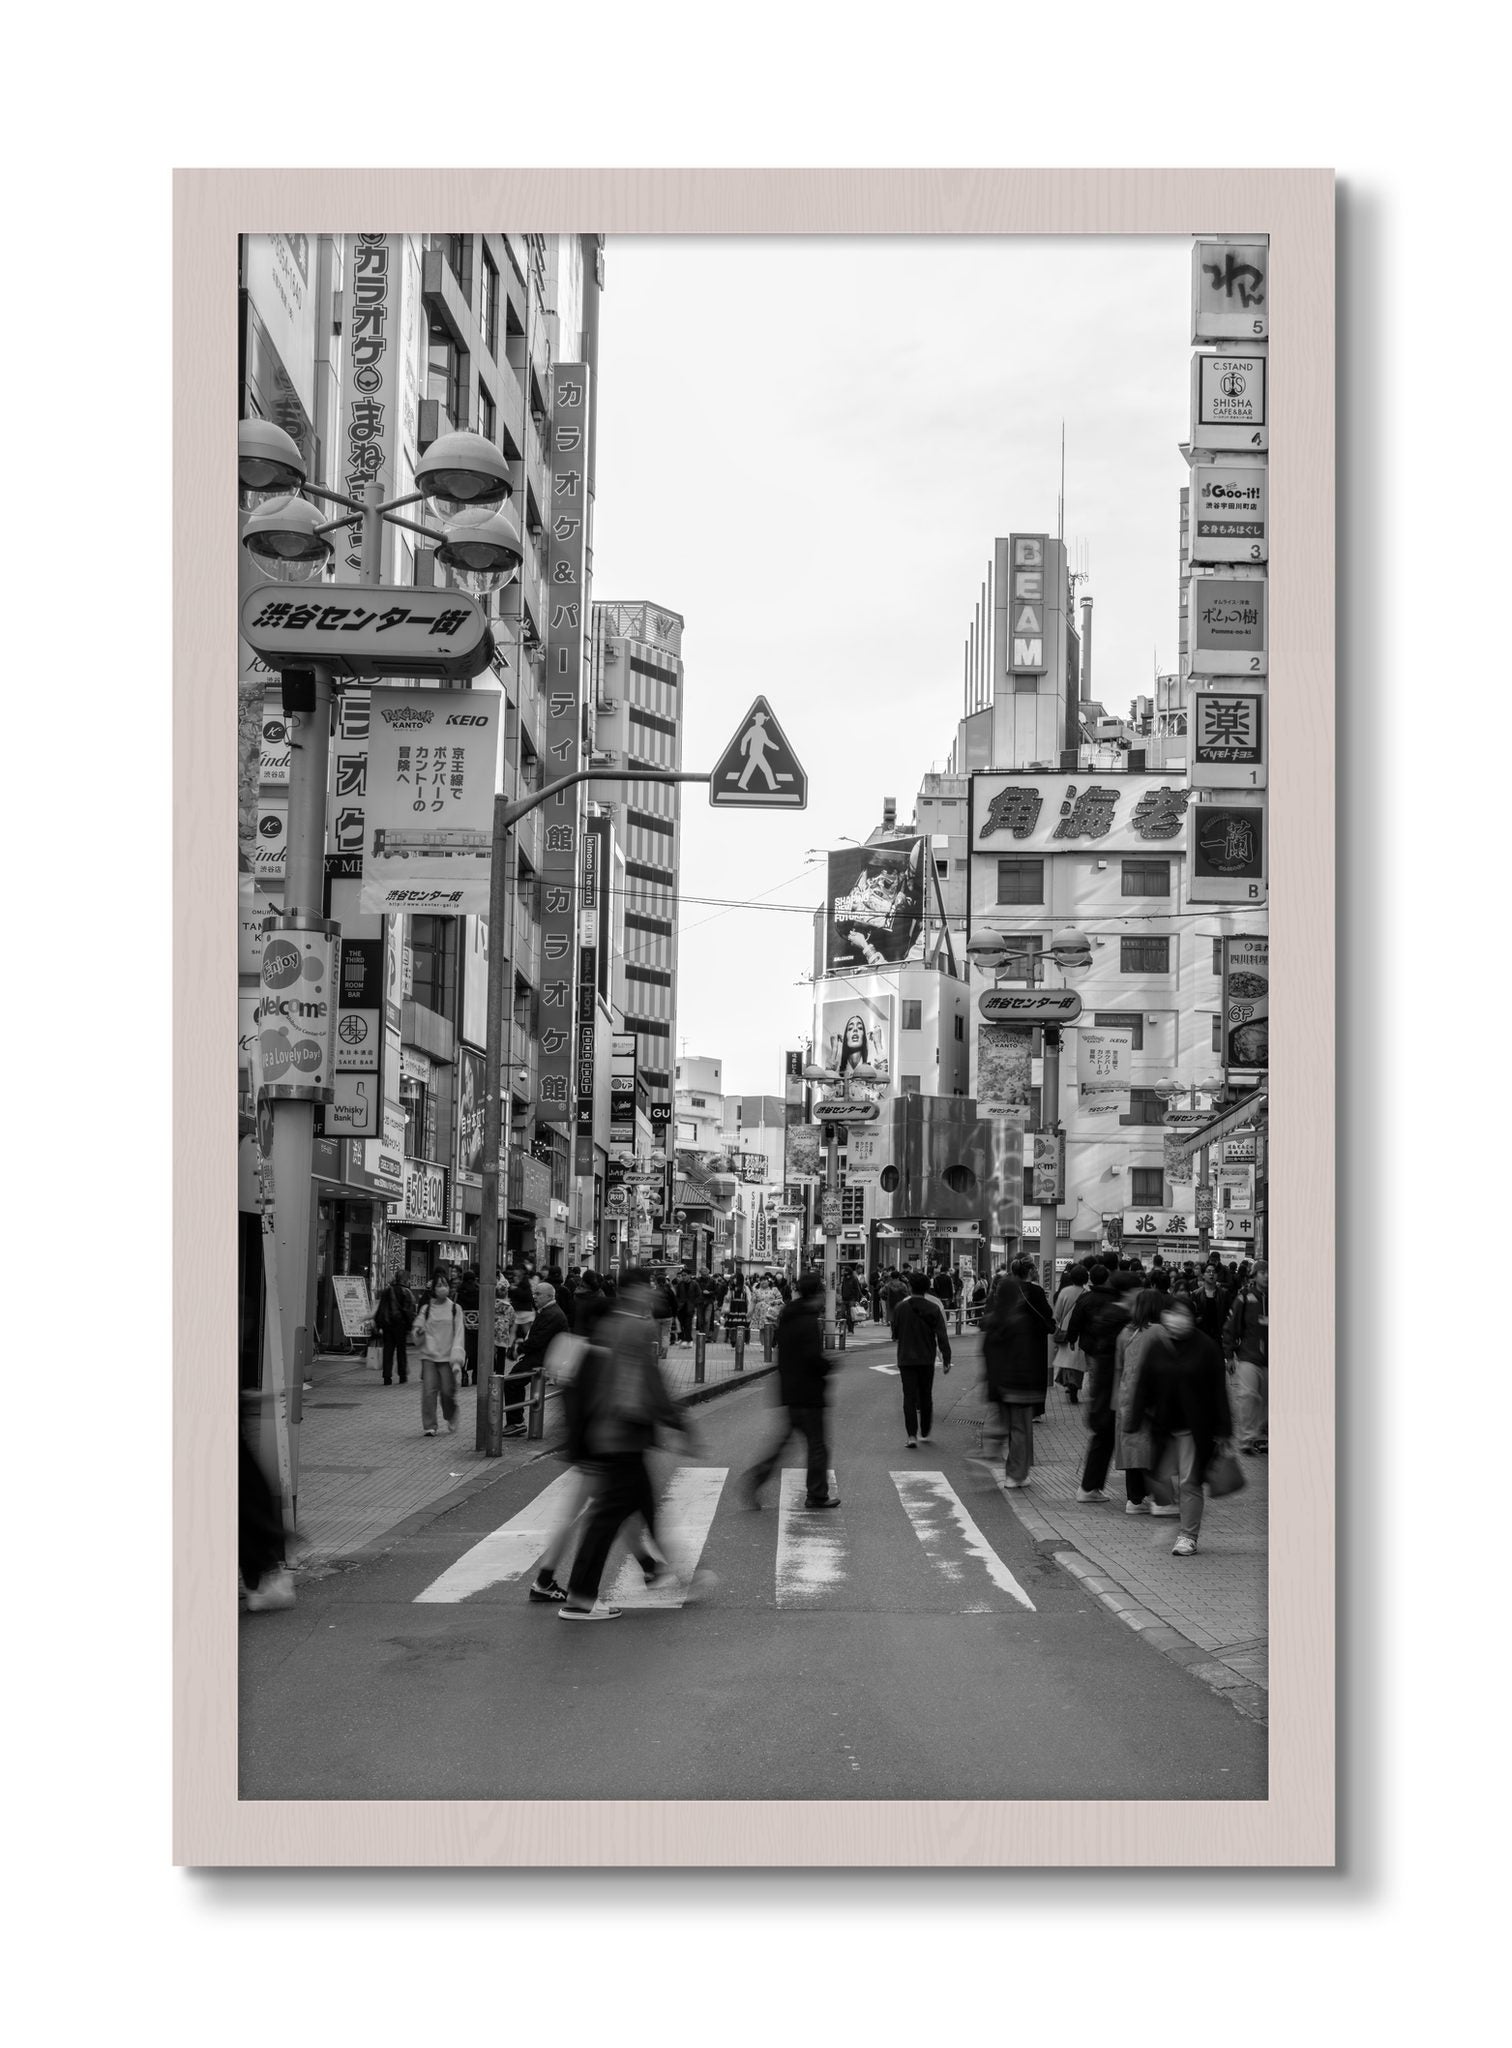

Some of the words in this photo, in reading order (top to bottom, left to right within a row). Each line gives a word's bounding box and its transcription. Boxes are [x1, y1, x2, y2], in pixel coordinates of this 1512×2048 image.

[1202, 254, 1264, 308] わん
[351, 246, 388, 367] カラオケ
[1252, 320, 1264, 334] 5
[1213, 362, 1253, 371] C.STAND
[1213, 398, 1253, 408] SHISHA
[1213, 408, 1253, 416] CAFE&BAR
[1211, 484, 1260, 499] Goo-it!
[1205, 502, 1257, 511] 渋谷宇田川町店
[1201, 524, 1261, 535] 全身もみほぐし
[1250, 544, 1261, 559] 3
[1014, 538, 1044, 667] BEAM
[252, 602, 473, 636] 渋谷センター街
[1249, 657, 1260, 671] 2
[392, 721, 424, 729] KANTO
[445, 714, 489, 727] KEIO
[1204, 700, 1250, 746] 薬
[1200, 748, 1255, 760] マツモトキヨシ
[396, 746, 411, 784] 冒険へ
[263, 770, 286, 778] 渋谷店
[413, 746, 429, 812] カントーの
[431, 746, 447, 813] ポケパーク
[450, 747, 465, 800] 京王線で
[1248, 770, 1257, 784] 1
[979, 785, 1189, 840] 角海老
[1200, 820, 1254, 863] 一蘭
[260, 865, 282, 873] 渋谷店
[385, 890, 464, 902] 渋谷センター街
[1248, 884, 1259, 898] B
[263, 951, 298, 982] Enjoy
[540, 888, 571, 1103] カラオケ館
[260, 996, 327, 1018] Welcome
[985, 997, 1076, 1010] 渋谷センター街
[1229, 1005, 1254, 1023] 6F
[275, 1047, 302, 1066] Lovely
[303, 1048, 321, 1061] Day!
[335, 1105, 364, 1115] Whisky
[652, 1109, 670, 1118] GU
[334, 1113, 352, 1122] Bank
[1135, 1214, 1188, 1233] 兆楽
